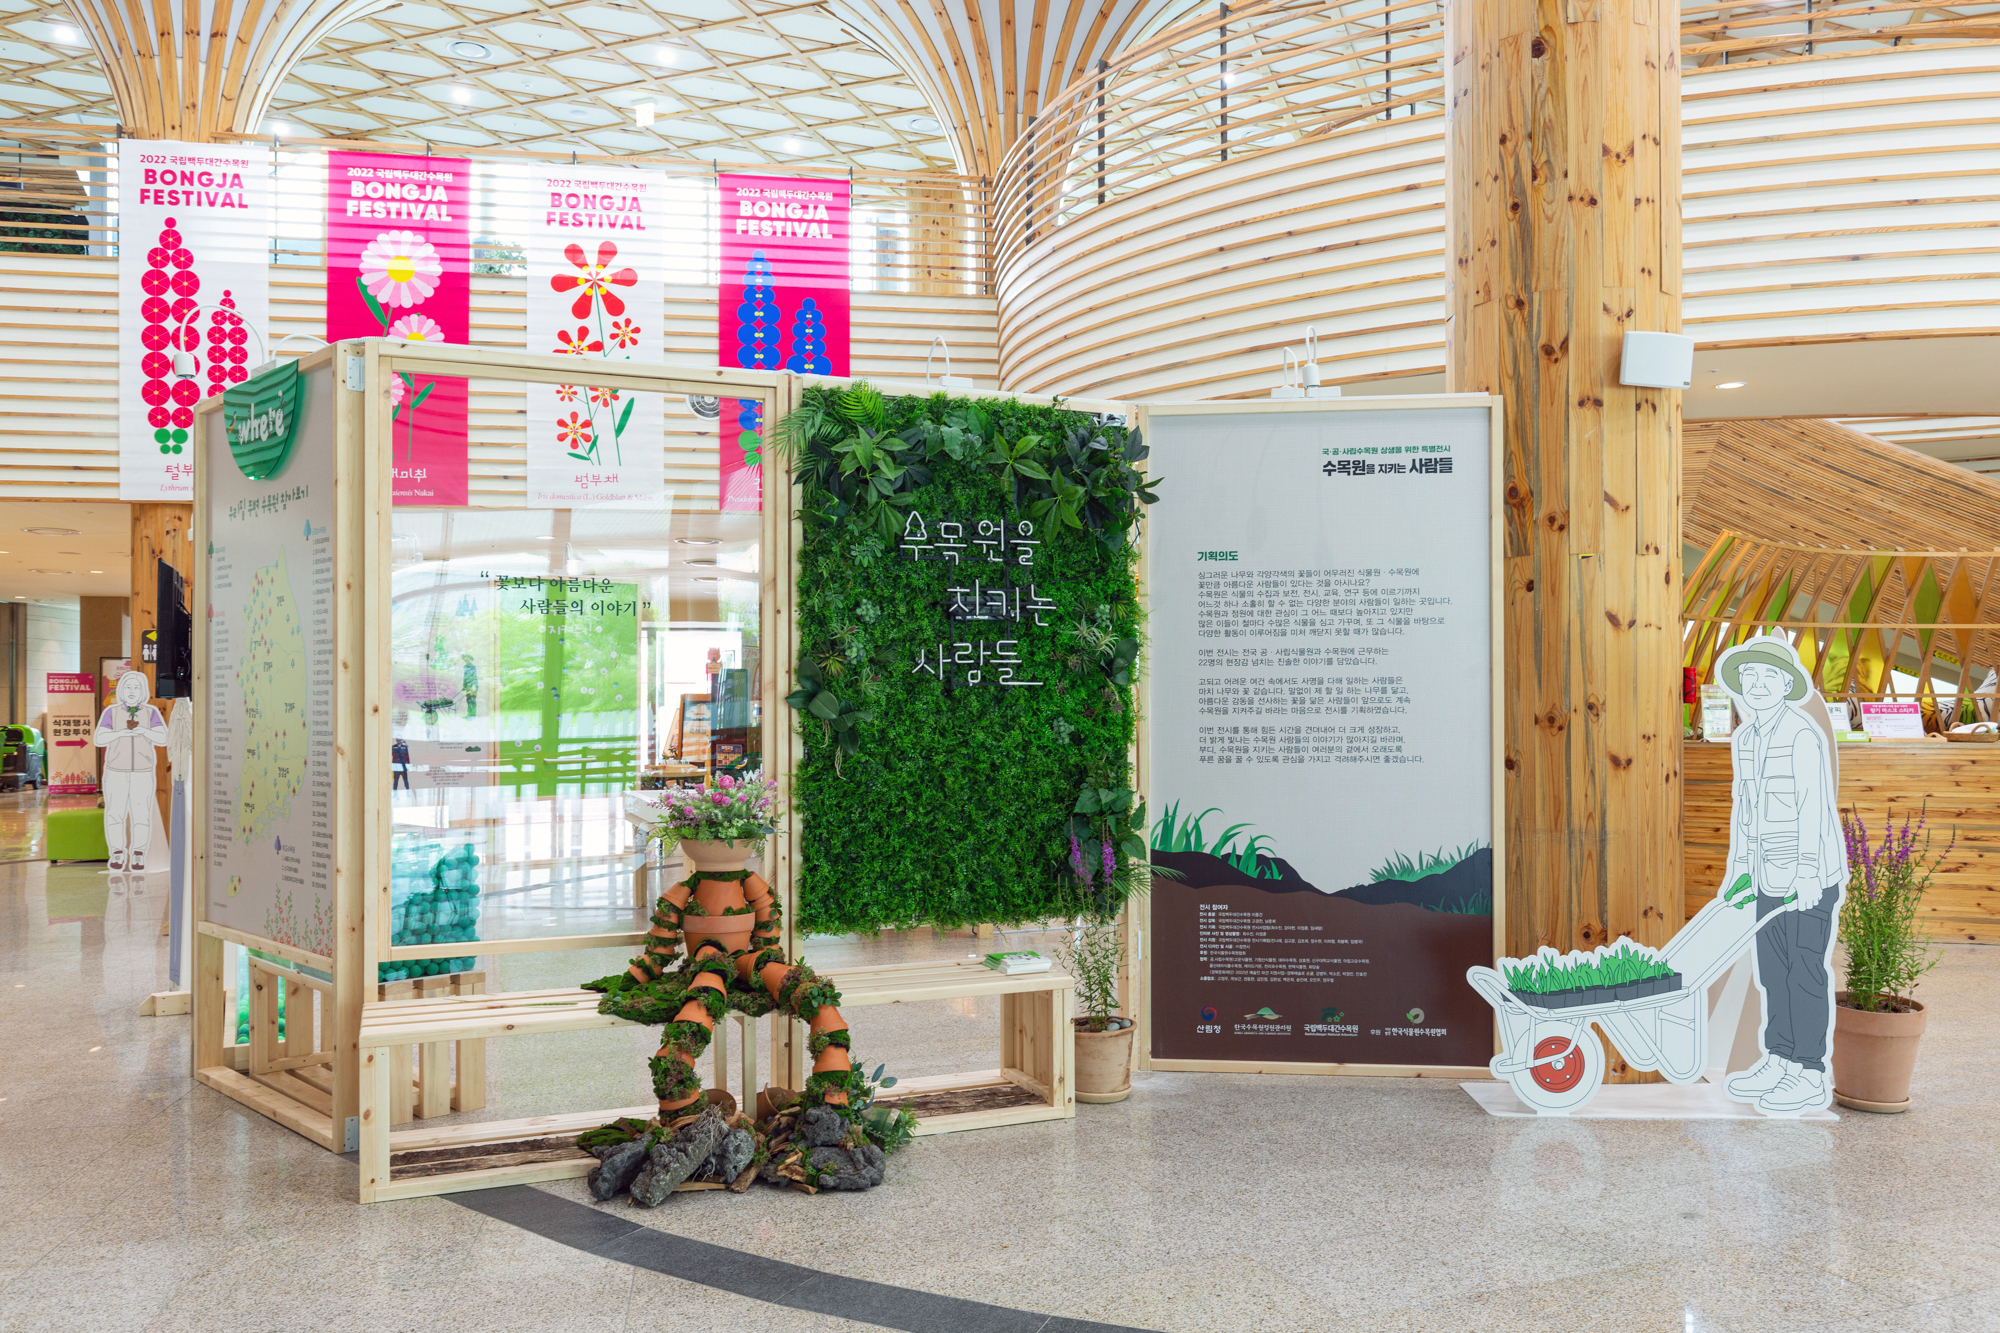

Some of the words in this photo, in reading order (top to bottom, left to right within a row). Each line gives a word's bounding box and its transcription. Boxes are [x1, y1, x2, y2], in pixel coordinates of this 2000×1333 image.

[140, 154, 167, 164] 2022
[170, 156, 249, 168] 국립백두대간수목원
[144, 168, 244, 188] BONGJA
[347, 167, 374, 177] 2022
[376, 168, 453, 182] 국립백두대간수목원
[351, 181, 448, 202] BONGJA
[547, 179, 571, 188] 2022
[574, 180, 646, 192] 국립백두대간수목원
[140, 188, 248, 208] FESTIVAL
[736, 188, 760, 197] 2022
[763, 189, 833, 201] 국립백두대간수목원
[551, 192, 642, 212] BONGJA
[347, 200, 452, 221] FESTIVAL
[740, 200, 829, 220] BONGJA
[546, 212, 646, 230] FESTIVAL
[736, 219, 832, 239] FESTIVAL
[238, 403, 285, 445] where
[1405, 446, 1419, 454] 위한
[1422, 445, 1451, 453] 특별전시
[164, 463, 194, 480] 털부
[1322, 459, 1375, 476] 수목원을
[1378, 463, 1406, 474] 지키는
[1409, 457, 1453, 474] 사람들
[160, 484, 189, 492] Lythrum
[574, 473, 619, 489] 범부채
[262, 492, 279, 513] 수목원
[899, 511, 1040, 566] 수목원을
[1197, 551, 1238, 561] 기획의도
[1197, 571, 1228, 580] 싱그러운
[1230, 570, 1253, 578] 나무와
[1256, 570, 1294, 578] 각양각색의
[1297, 569, 1320, 578] 꽃들이
[1323, 569, 1354, 578] 어우러진
[1357, 568, 1380, 577] 식물원
[1388, 568, 1419, 576] 수목원에
[550, 577, 614, 594] 아름다운
[1197, 580, 1220, 589] 꽃만큼
[1223, 580, 1253, 589] 아름다운
[1256, 580, 1287, 588] 사람들이
[1289, 579, 1313, 588] 있다는
[1316, 578, 1331, 587] 것을
[1333, 578, 1370, 586] 아시나요?
[1197, 590, 1228, 598] 수목원은
[1230, 590, 1254, 598] 식물의
[1256, 589, 1279, 598] 수집과
[1343, 588, 1359, 597] 연구
[1362, 588, 1378, 596] 등에
[520, 598, 584, 615] 사람들의
[947, 579, 1056, 626] 지키는
[1223, 600, 1238, 608] 하나
[1267, 599, 1275, 608] 할
[1277, 599, 1285, 607] 수
[1288, 599, 1303, 607] 없는
[1306, 598, 1329, 607] 다양한
[1332, 598, 1356, 606] 분야의
[1358, 598, 1389, 606] 사람들이
[1392, 597, 1416, 606] 일하는
[1418, 597, 1452, 605] 곳입니다.
[1198, 629, 1221, 637] 다양한
[1223, 629, 1246, 637] 활동이
[1249, 628, 1287, 637] 이루어짐을
[1334, 627, 1350, 636] 못할
[1352, 627, 1368, 635] 때가
[1371, 627, 1404, 635] 많습니다.
[1198, 649, 1213, 657] 이번
[1216, 648, 1239, 657] 전시는
[1241, 648, 1257, 657] 전국
[1323, 647, 1355, 655] 수목원에
[1357, 647, 1389, 655] 근무하는
[912, 639, 1044, 685] 사람들
[1198, 658, 1223, 666] 22명의
[1225, 658, 1248, 666] 현장감
[1251, 658, 1274, 666] 넘치는
[1277, 657, 1300, 666] 진솔한
[1302, 657, 1333, 666] 이야기를
[1336, 657, 1379, 665] 담았습니다.
[1198, 706, 1229, 715] 수목원을
[1231, 706, 1262, 715] 지켜주길
[1264, 706, 1288, 715] 바라는
[1290, 706, 1321, 714] 마음으로
[1324, 706, 1347, 714] 전시를
[1350, 706, 1407, 714] 기획하였습니다.
[53, 719, 91, 727] 식재행사
[1198, 726, 1214, 734] 이번
[1216, 726, 1239, 734] 전시를
[1242, 726, 1258, 734] 통해
[1260, 725, 1276, 734] 힘든
[1278, 725, 1301, 734] 시간을
[1218, 745, 1249, 754] 수목원을
[1252, 745, 1275, 754] 지키는
[1277, 745, 1308, 754] 사람들이
[1311, 745, 1342, 753] 여러분의
[1345, 745, 1368, 753] 곁에서
[1371, 745, 1402, 753] 오래도록
[1196, 1024, 1221, 1034] 산림청
[1303, 1024, 1358, 1033] 국립백두대간수목원
